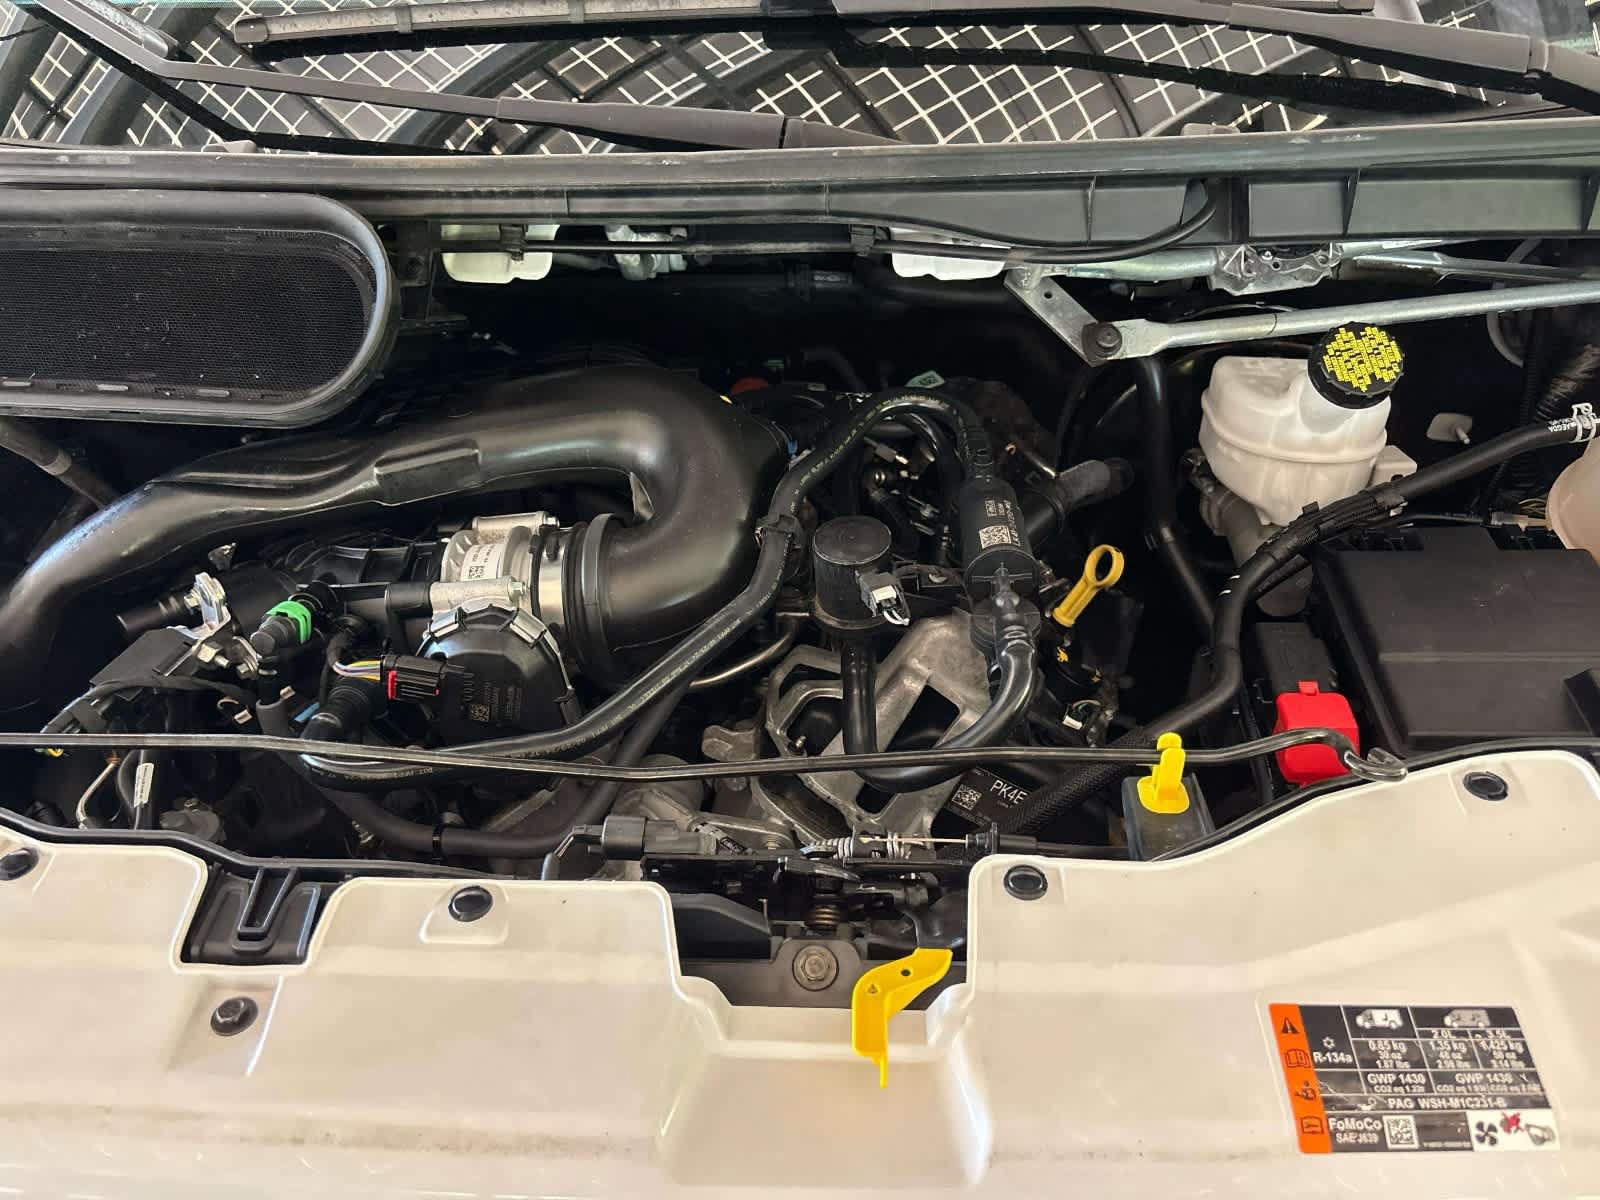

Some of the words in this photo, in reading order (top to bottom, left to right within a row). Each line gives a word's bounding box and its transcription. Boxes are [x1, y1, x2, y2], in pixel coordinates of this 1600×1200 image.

[990, 779, 1028, 805] PK4E
[1392, 1040, 1407, 1053] kg
[1451, 1040, 1467, 1053] kg
[1313, 1051, 1353, 1064] R-134a
[1367, 1073, 1396, 1085] GWP
[1398, 1073, 1426, 1085] 1430
[1455, 1073, 1484, 1084] GWP
[1486, 1073, 1513, 1084] 1430
[1388, 1098, 1414, 1108] PAG
[1328, 1117, 1382, 1130] FoMoCo
